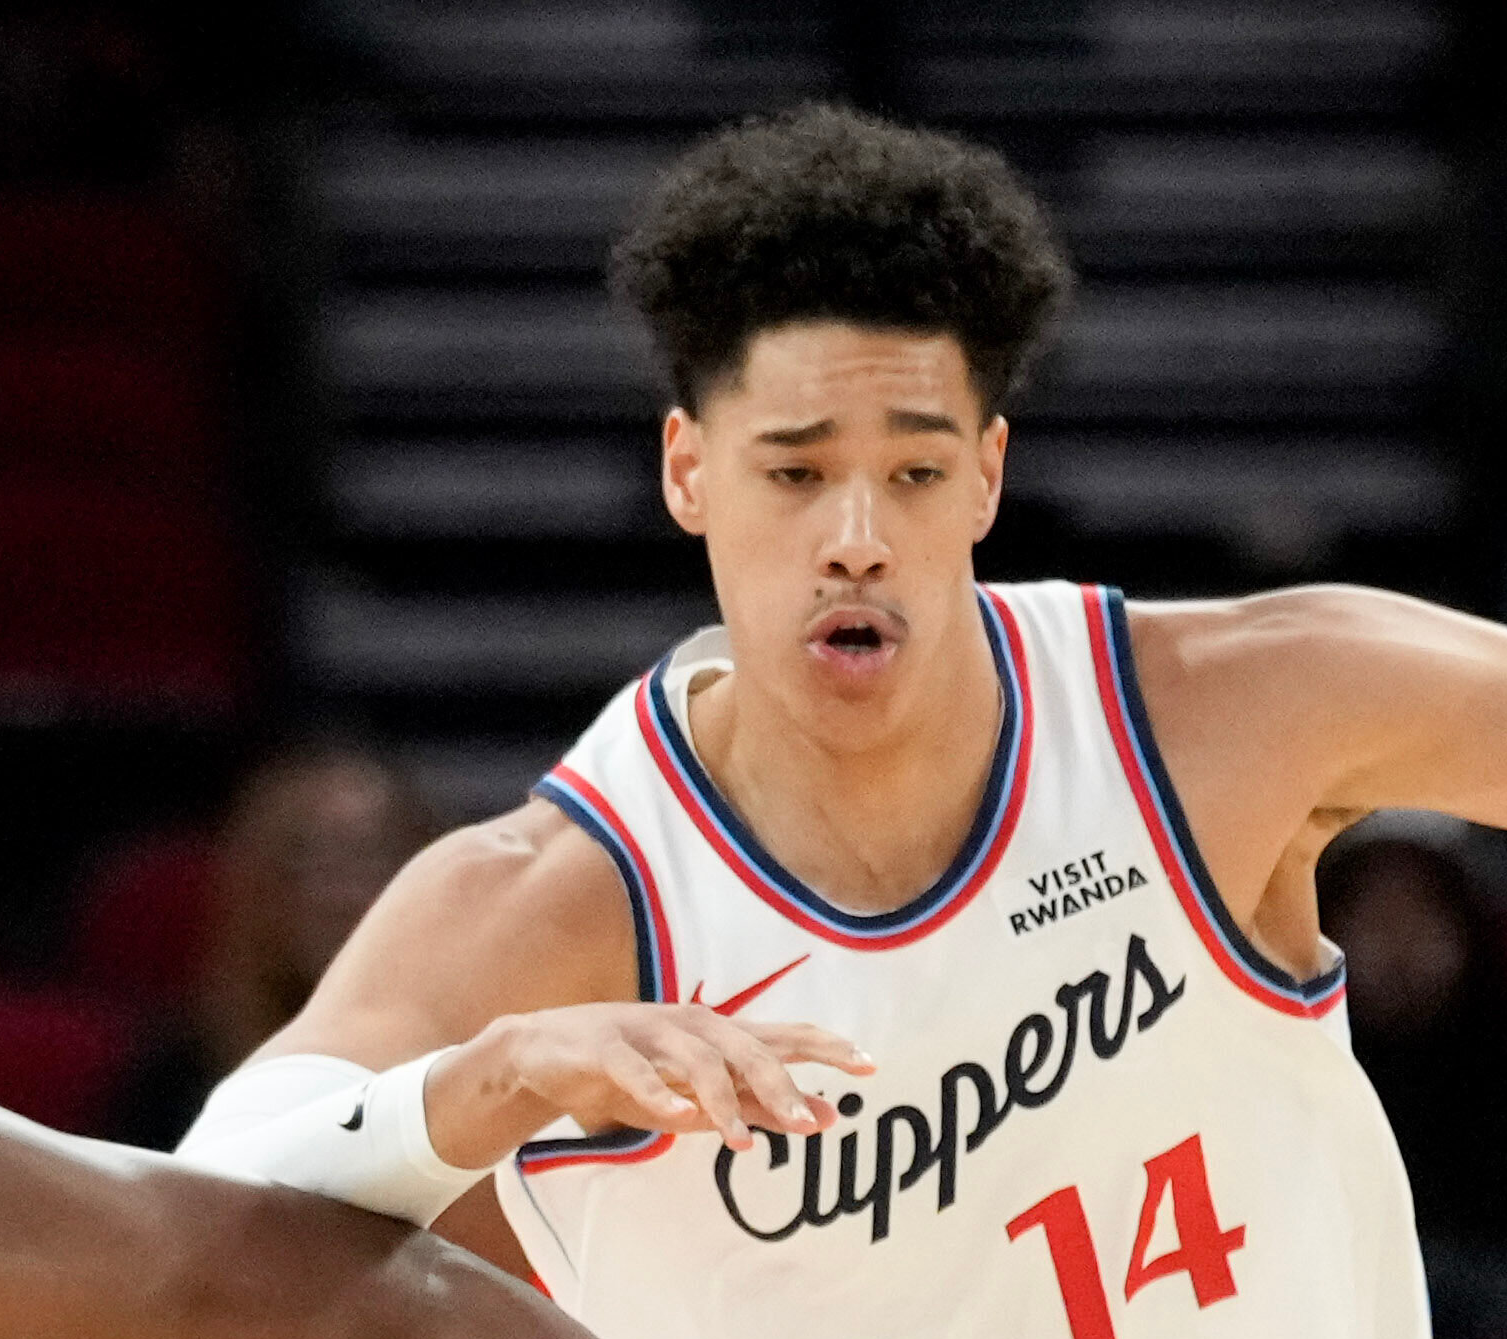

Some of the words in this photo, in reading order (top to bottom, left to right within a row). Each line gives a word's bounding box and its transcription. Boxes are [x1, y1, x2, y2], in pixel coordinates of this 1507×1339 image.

[1009, 866, 1148, 935] RWANDA
[1028, 850, 1105, 897] VISIT
[713, 933, 1187, 1245] Clippers
